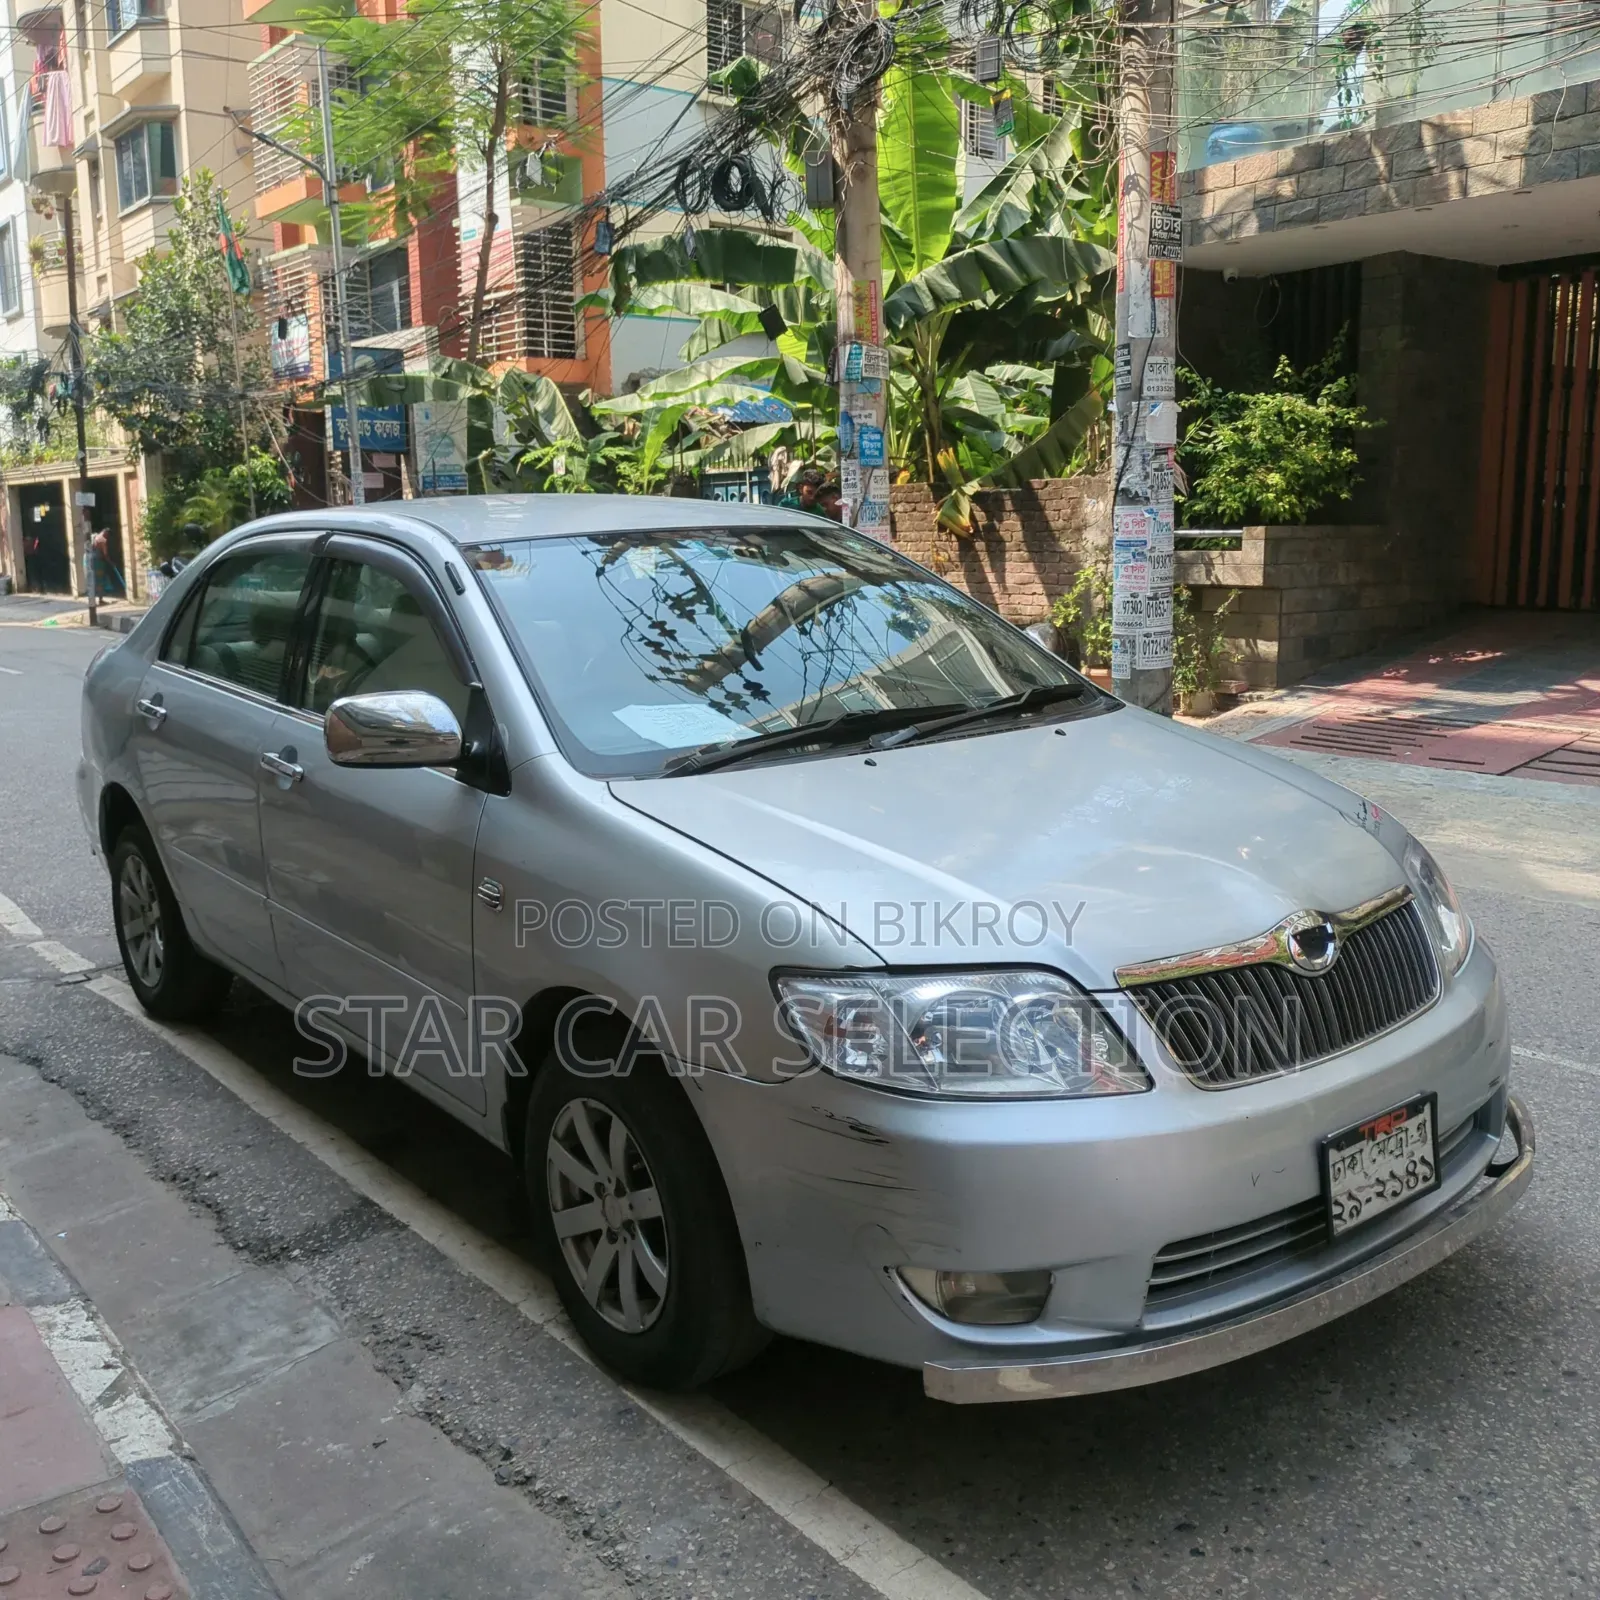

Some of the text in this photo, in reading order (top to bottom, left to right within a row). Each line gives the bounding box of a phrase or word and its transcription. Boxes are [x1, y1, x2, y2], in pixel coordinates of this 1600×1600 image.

[1151, 210, 1181, 232] টিচার
[373, 420, 400, 439] কলেজ
[1331, 1148, 1364, 1182] ঢাকা
